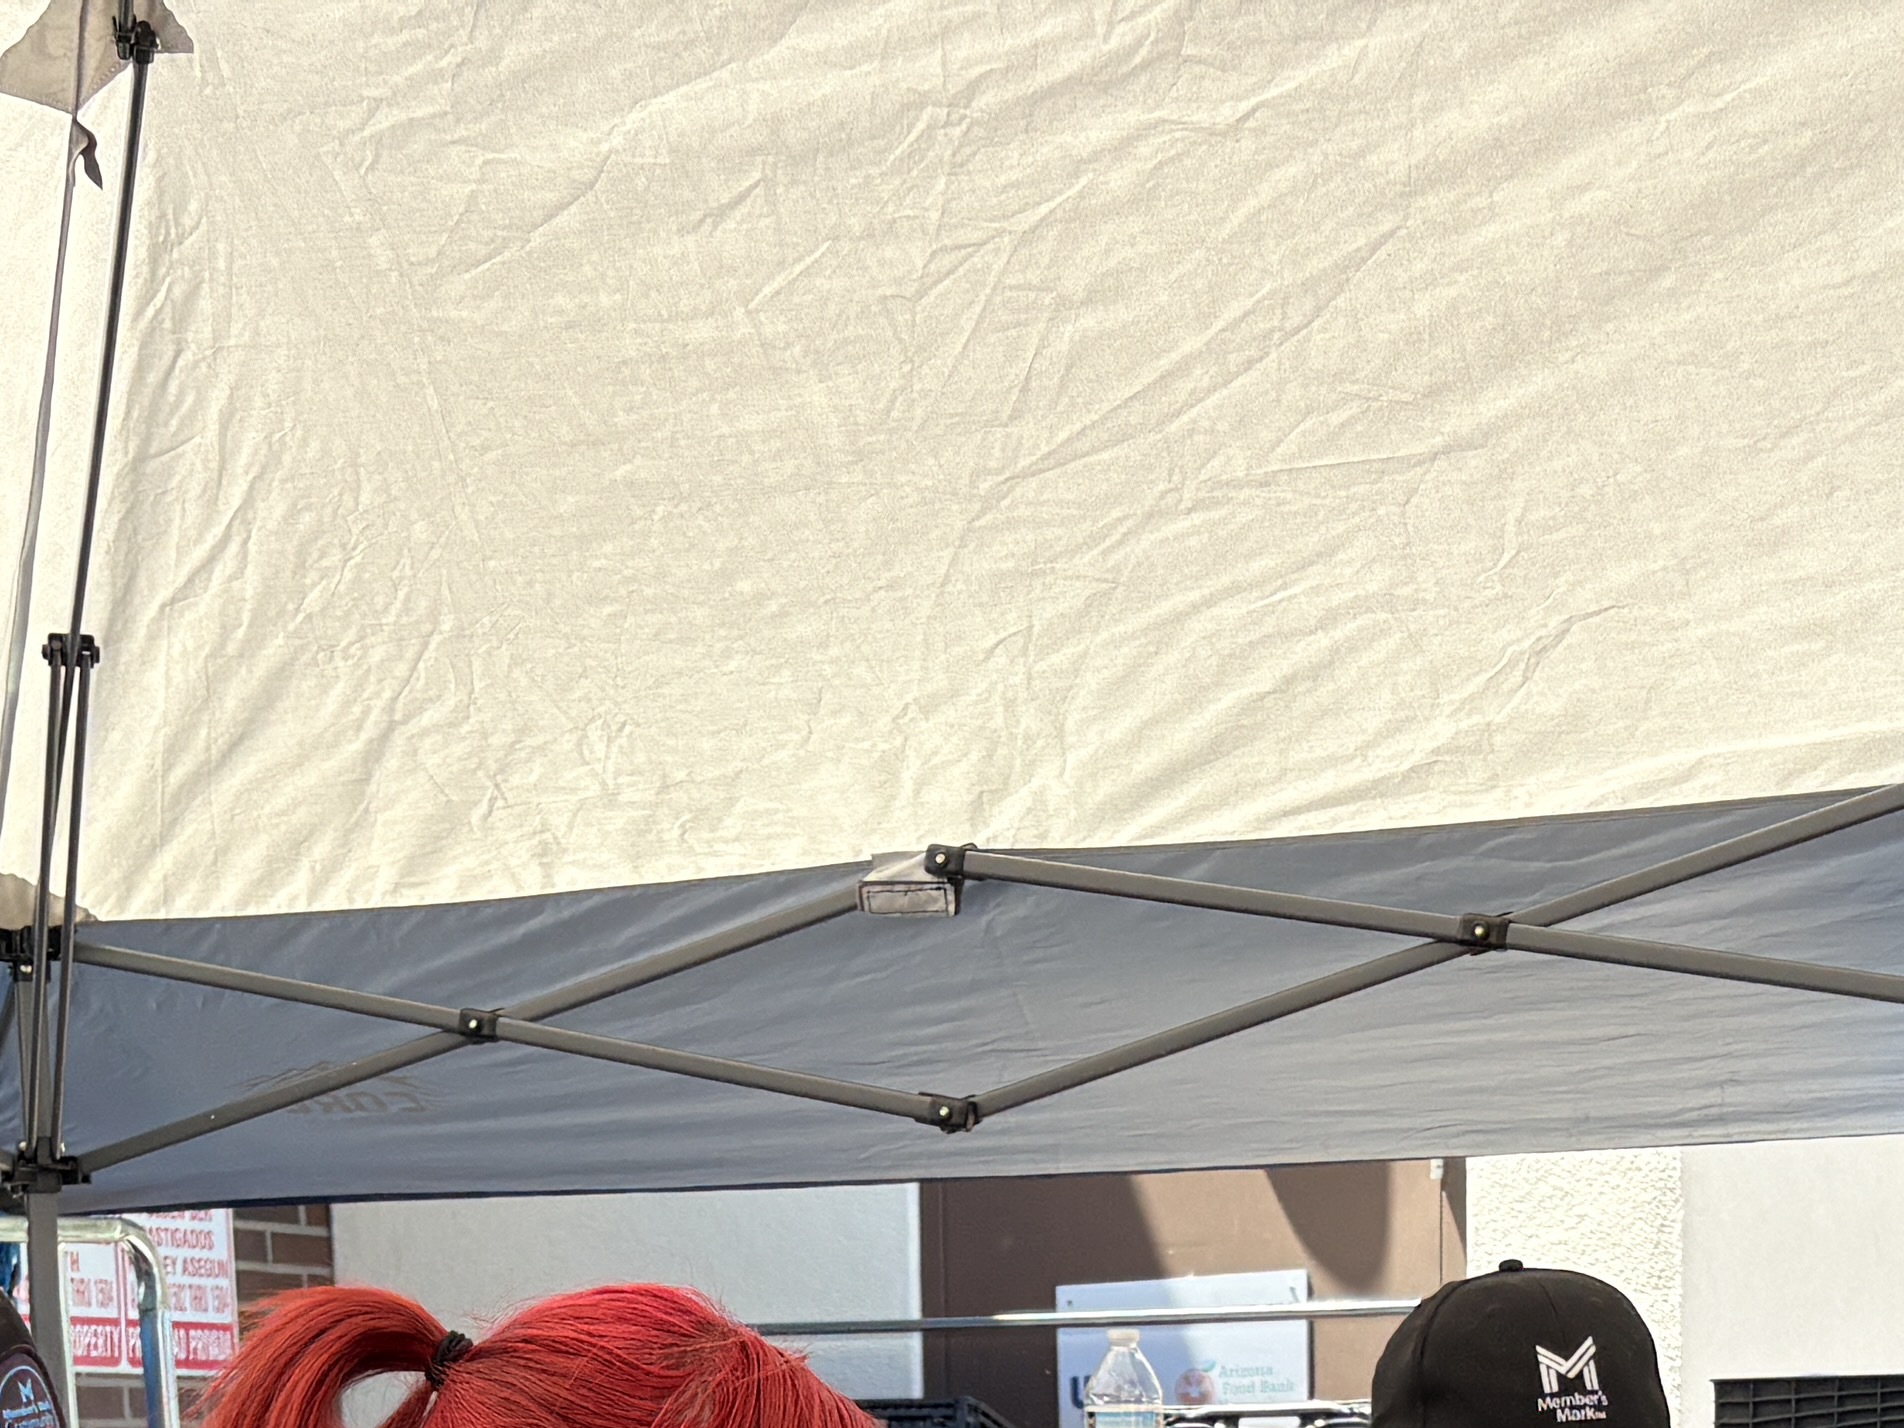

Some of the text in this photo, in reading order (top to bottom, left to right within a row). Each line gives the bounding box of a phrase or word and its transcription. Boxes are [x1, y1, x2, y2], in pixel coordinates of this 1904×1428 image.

[147, 1227, 215, 1251] ASTIGADOS
[163, 1256, 178, 1277] EY
[1218, 1364, 1274, 1379] Arizona
[1222, 1376, 1297, 1397] Food Bank
[1536, 1390, 1609, 1413] Member's
